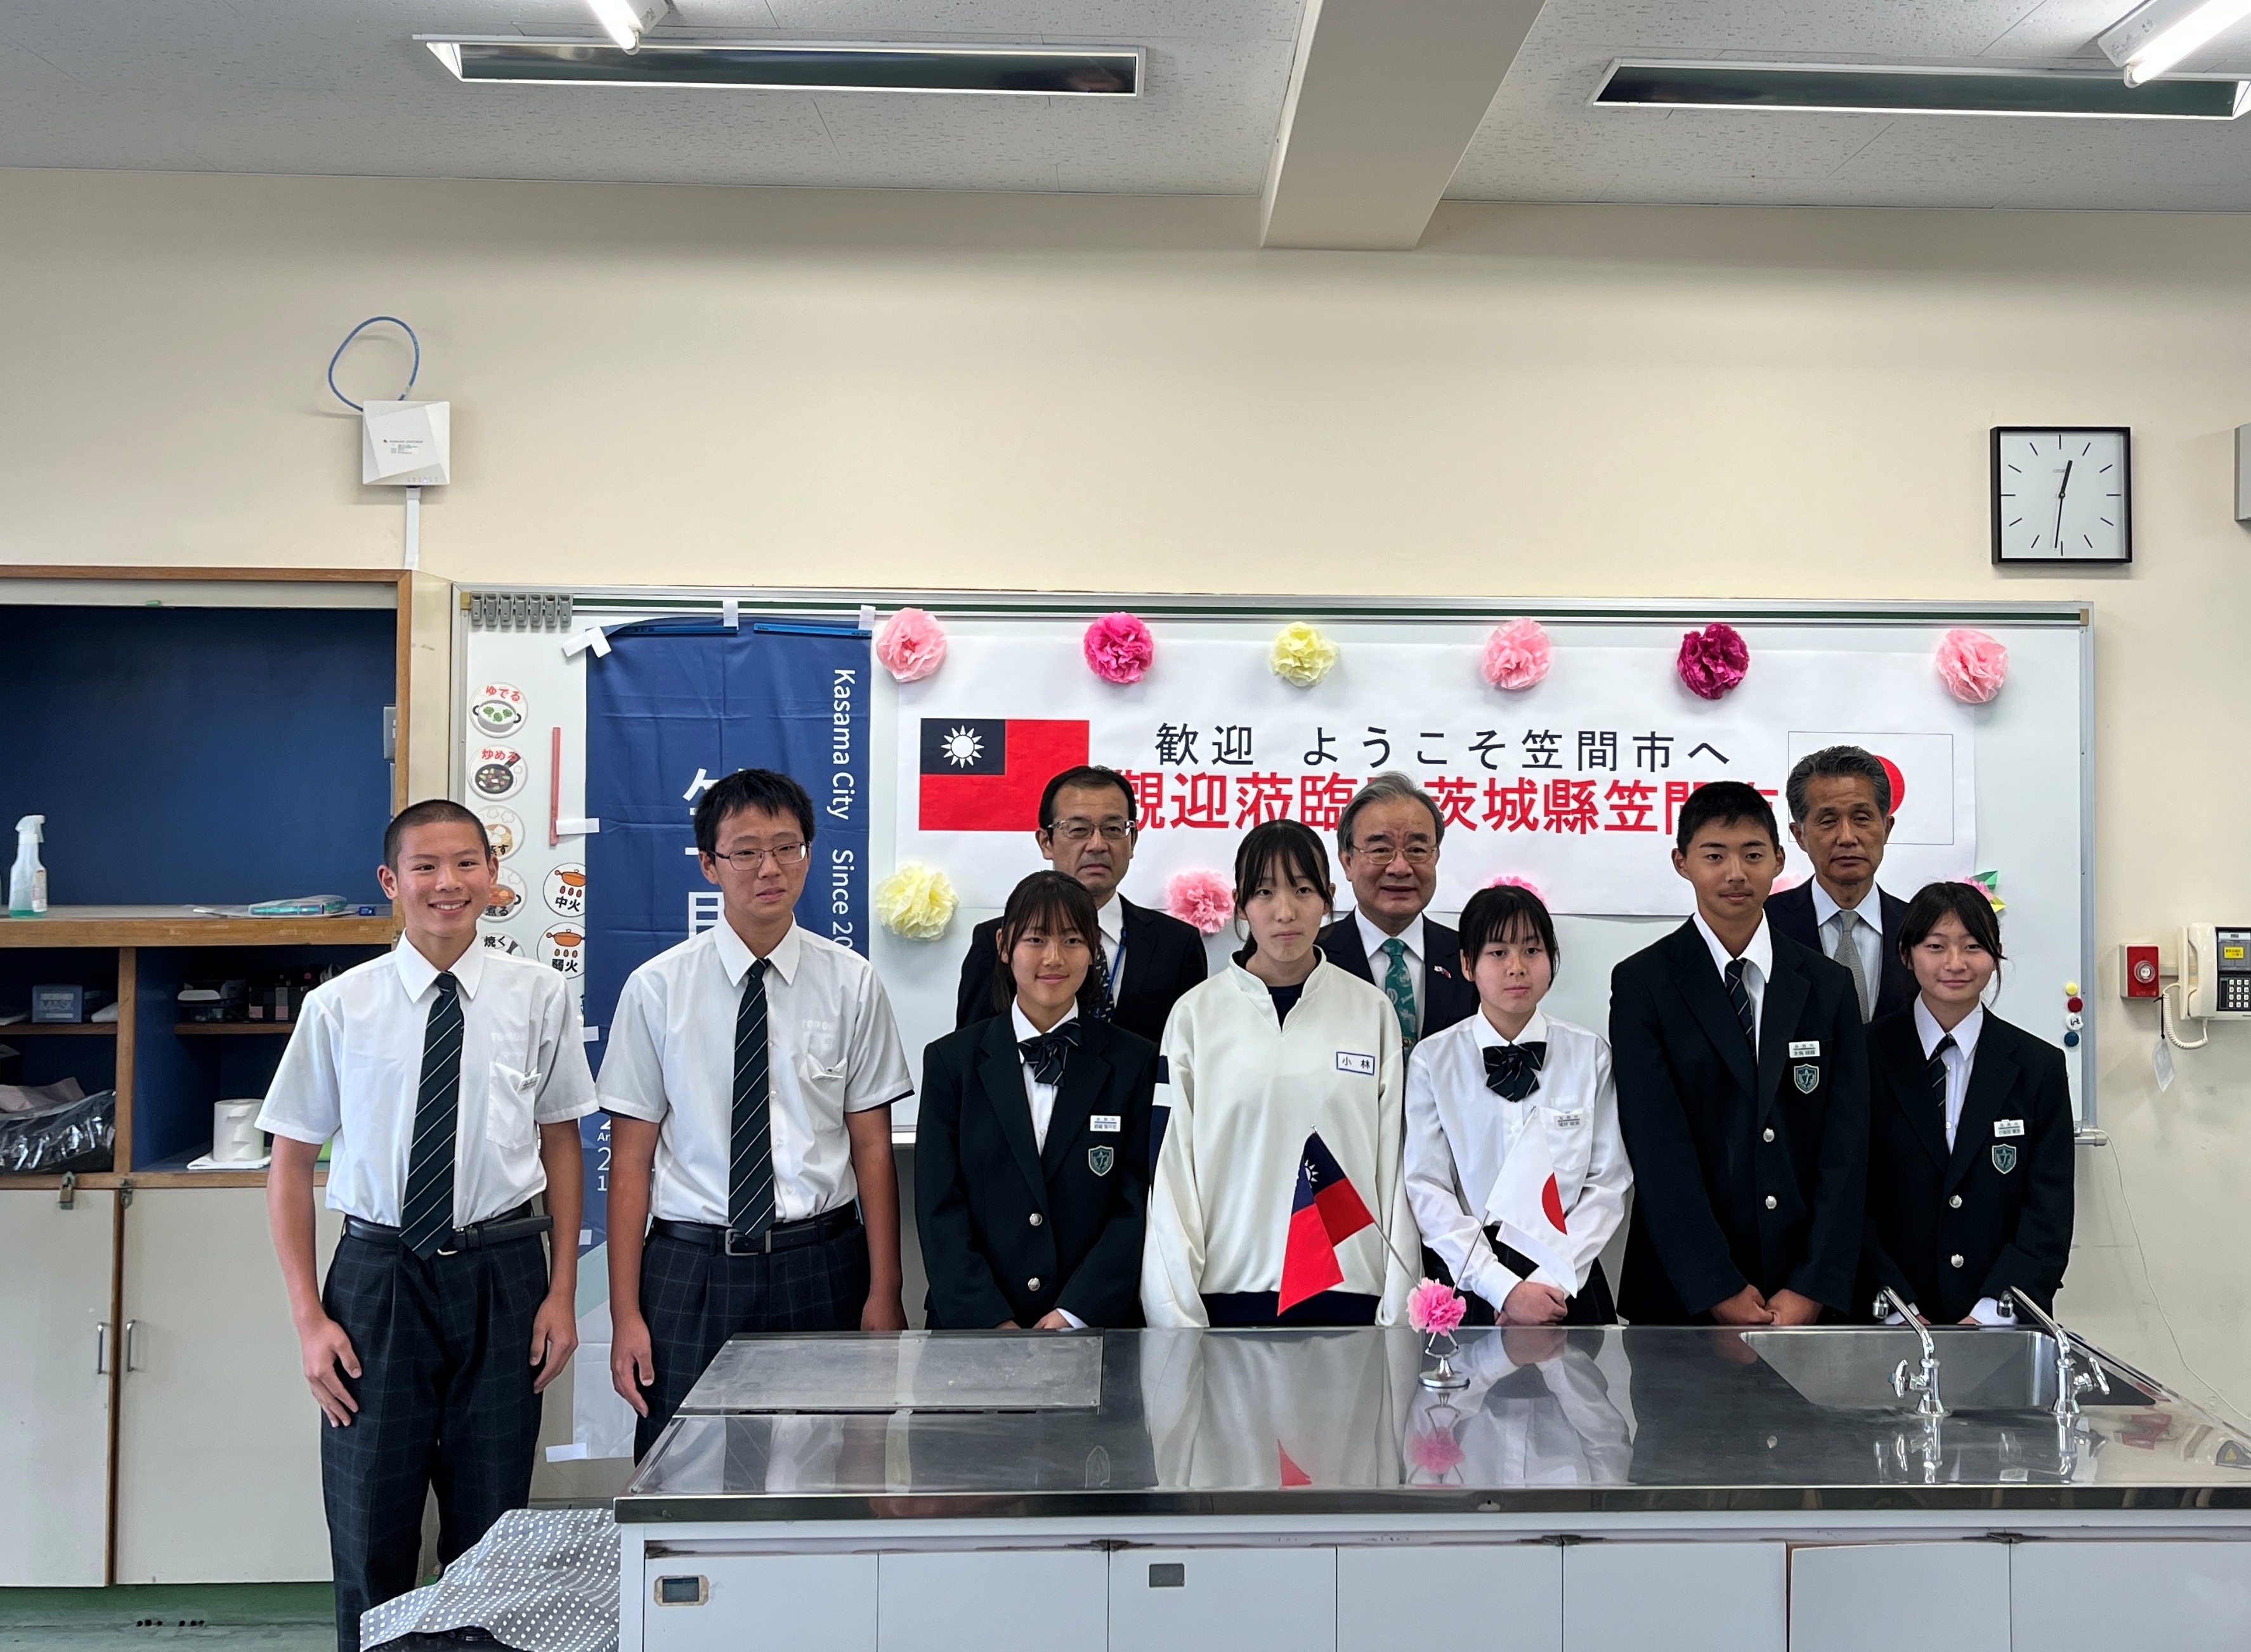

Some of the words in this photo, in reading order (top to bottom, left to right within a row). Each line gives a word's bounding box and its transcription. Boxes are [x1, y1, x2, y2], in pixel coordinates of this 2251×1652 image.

[486, 685, 521, 701] ゆでる
[832, 669, 856, 765] Kasama
[481, 748, 518, 761] 炒める
[1154, 722, 1254, 766] 歓迎
[1303, 726, 1730, 773] ようこそ笠間市へ
[826, 772, 855, 820] City
[832, 849, 855, 914] Since
[555, 895, 581, 912] 中火
[484, 935, 506, 947] 焼く
[1341, 1057, 1371, 1069] 小林
